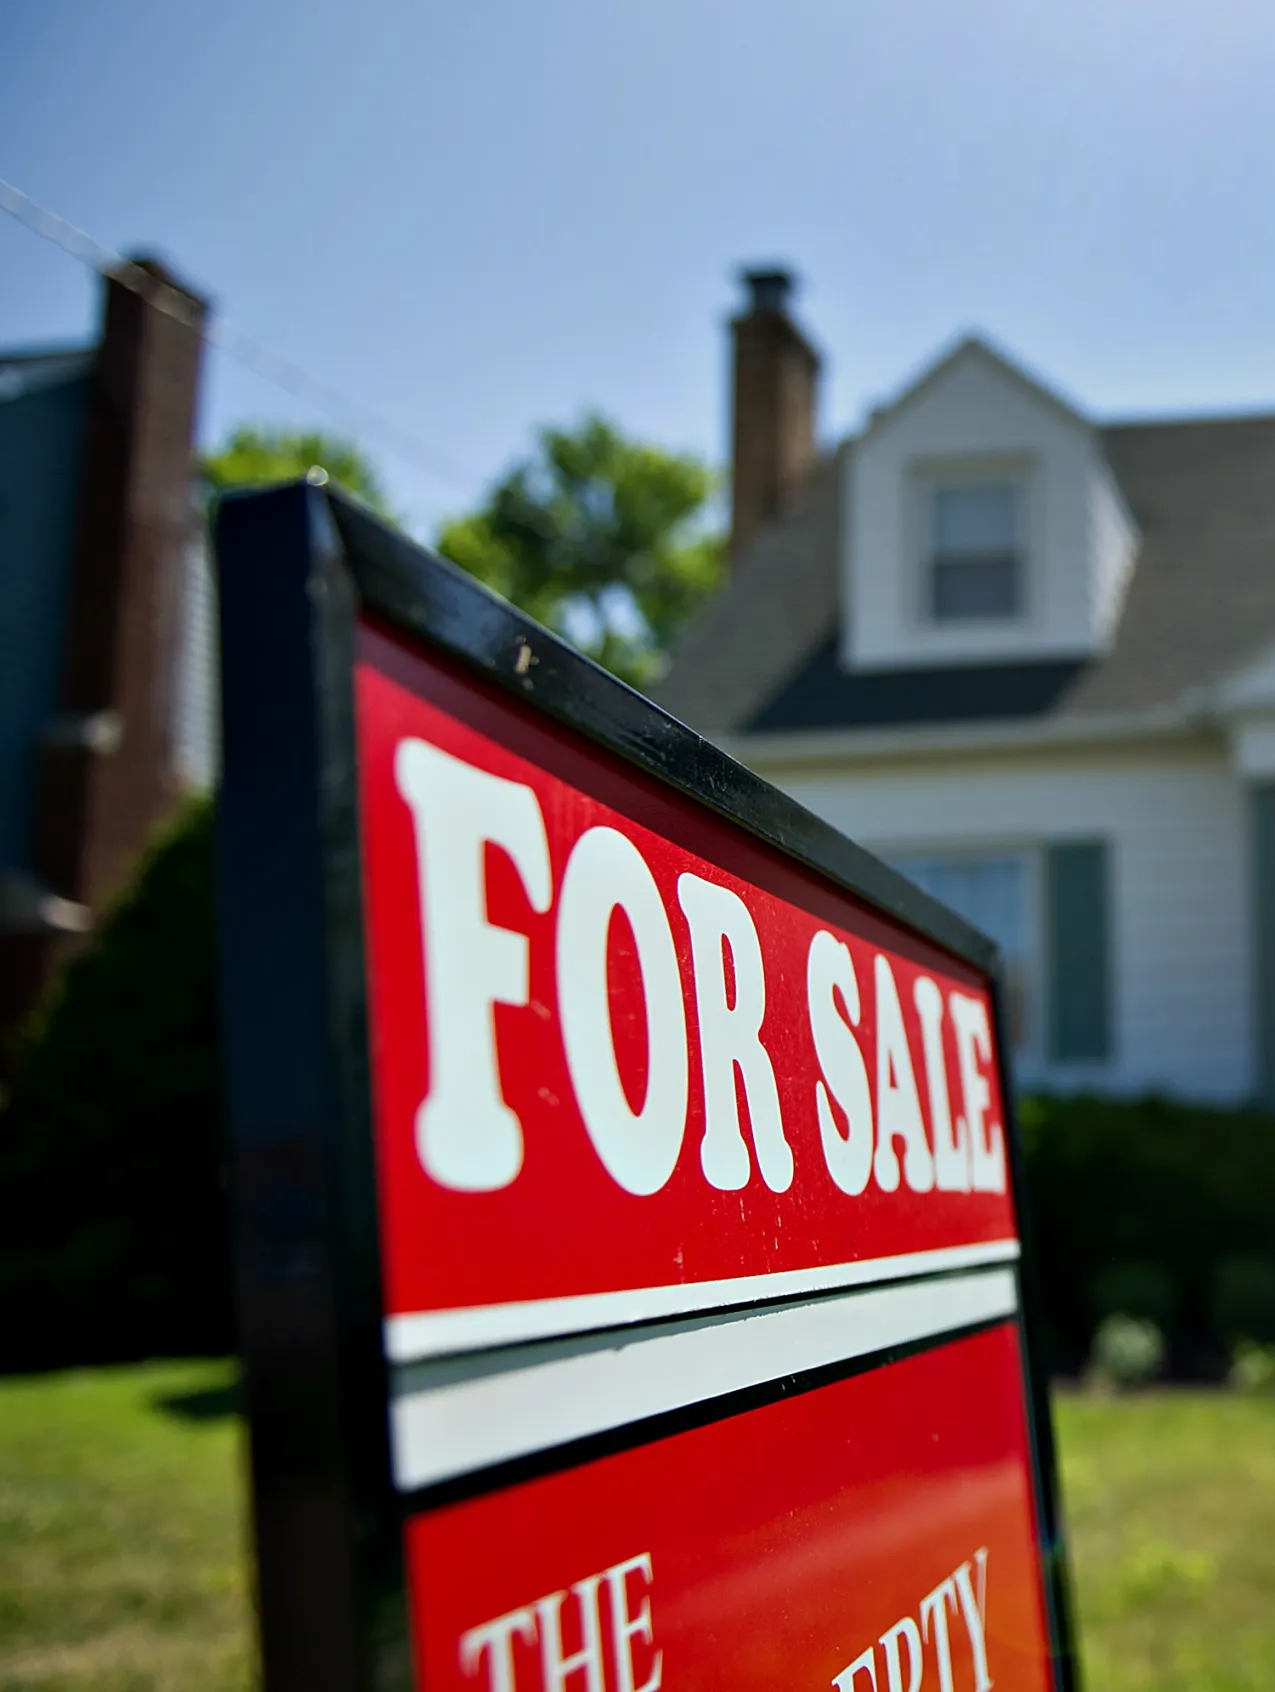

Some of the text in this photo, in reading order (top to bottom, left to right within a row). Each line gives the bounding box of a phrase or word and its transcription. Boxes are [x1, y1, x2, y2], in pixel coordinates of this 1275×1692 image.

[395, 737, 1004, 1196] FOR SALE
[459, 1552, 664, 1692] THE
[831, 1546, 994, 1692] TY
